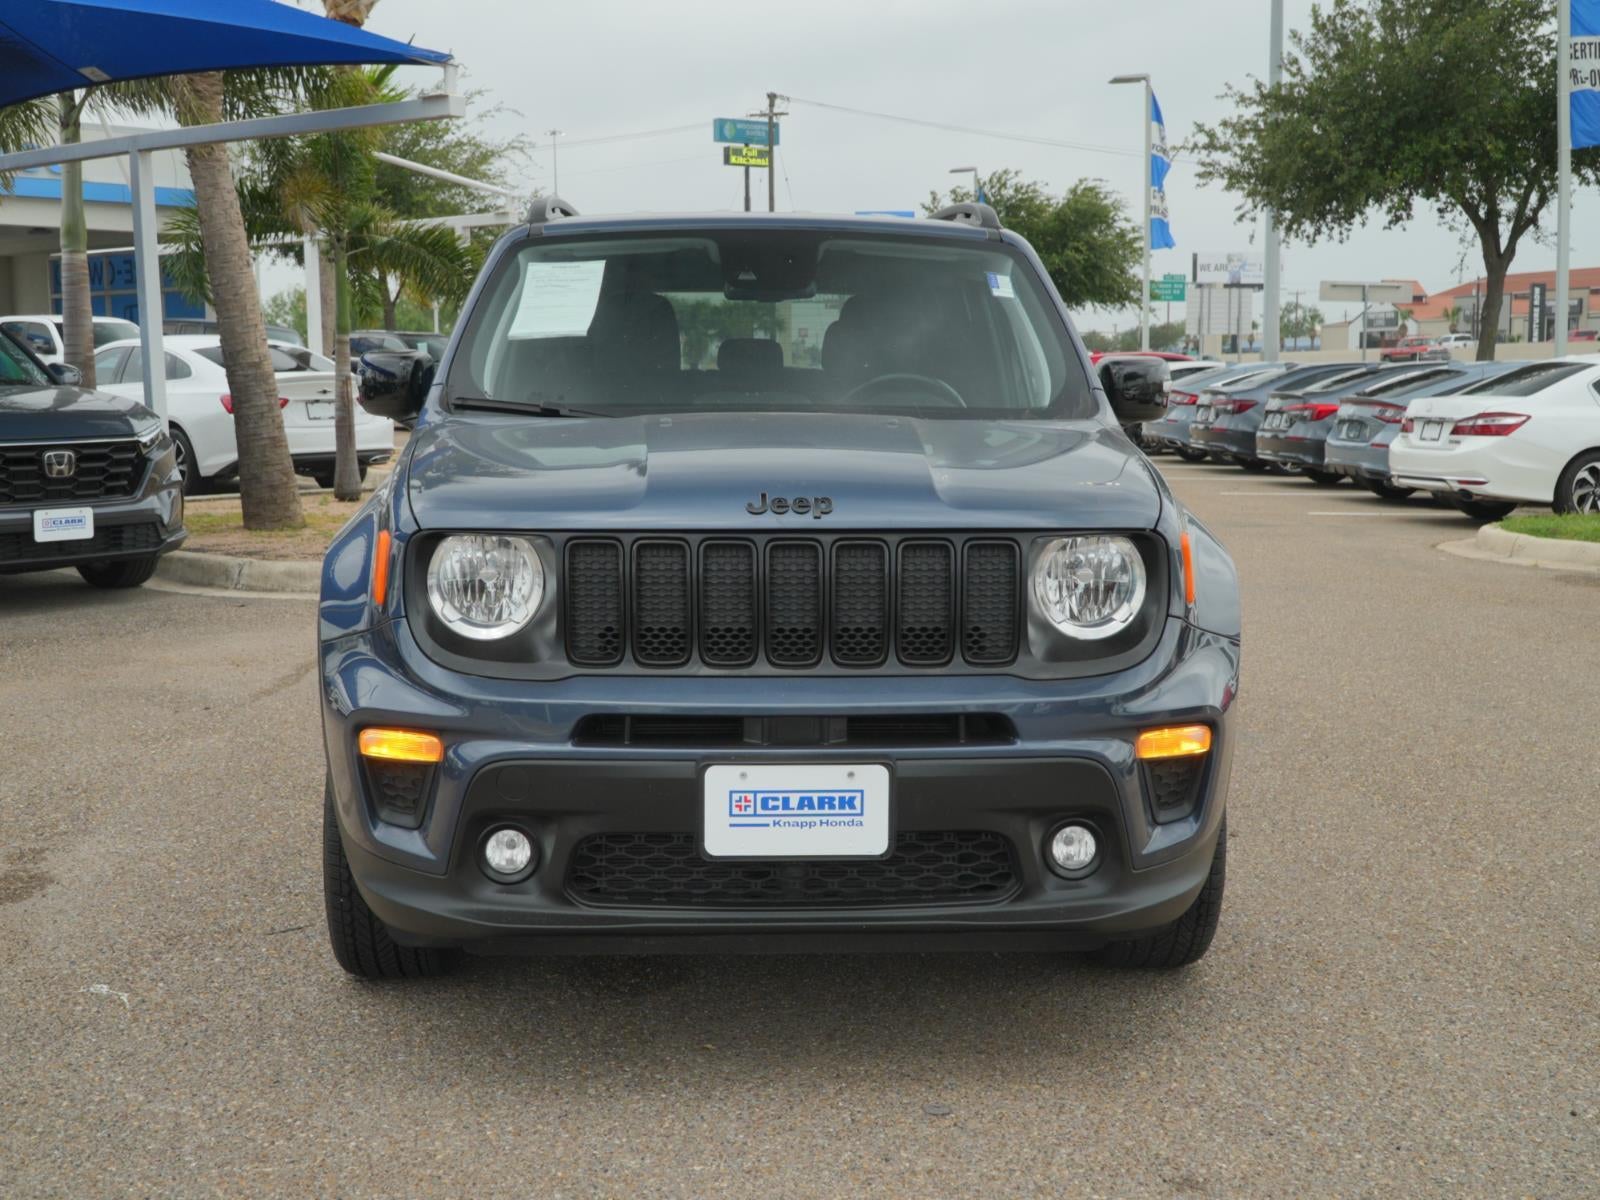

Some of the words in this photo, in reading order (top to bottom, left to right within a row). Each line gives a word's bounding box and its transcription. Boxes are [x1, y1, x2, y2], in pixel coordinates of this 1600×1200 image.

[1570, 41, 1600, 60] ERTI
[1199, 263, 1212, 272] WE
[745, 492, 833, 520] Jeep
[760, 796, 857, 811] CLARK
[772, 819, 817, 829] Knapp
[819, 818, 864, 827] Honda
